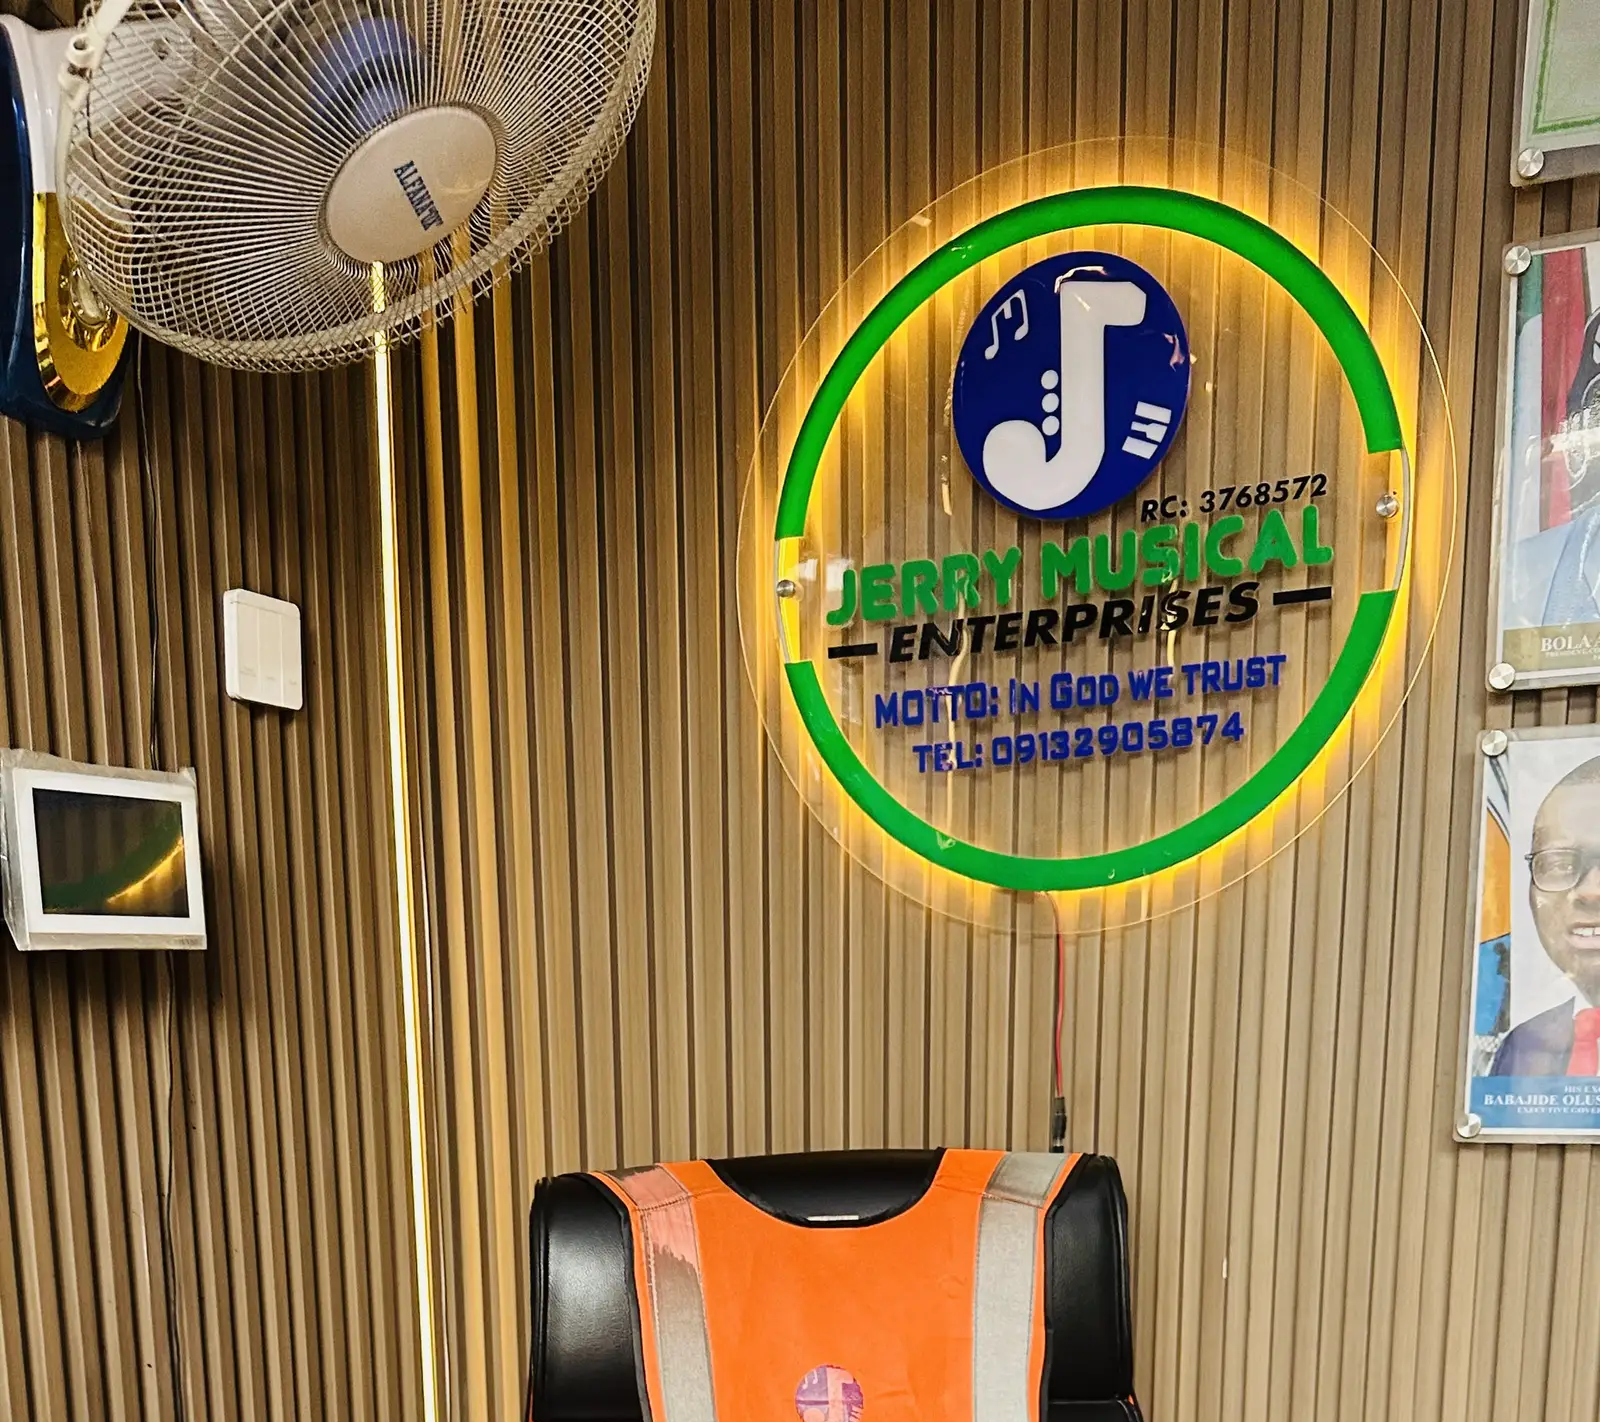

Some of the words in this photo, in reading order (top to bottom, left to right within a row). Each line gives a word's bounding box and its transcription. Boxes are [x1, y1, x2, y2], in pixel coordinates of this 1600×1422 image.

[1141, 496, 1188, 522] RC:
[1200, 473, 1328, 513] 3768572
[826, 546, 1021, 626] JERRY
[1041, 504, 1334, 599] MUSICAL
[889, 581, 1260, 663] ENTERPRISES
[875, 682, 998, 728] MOTTO:
[912, 741, 983, 773] TEL:
[992, 711, 1245, 765] 09132905874
[1484, 1094, 1559, 1106] BABAJIDE
